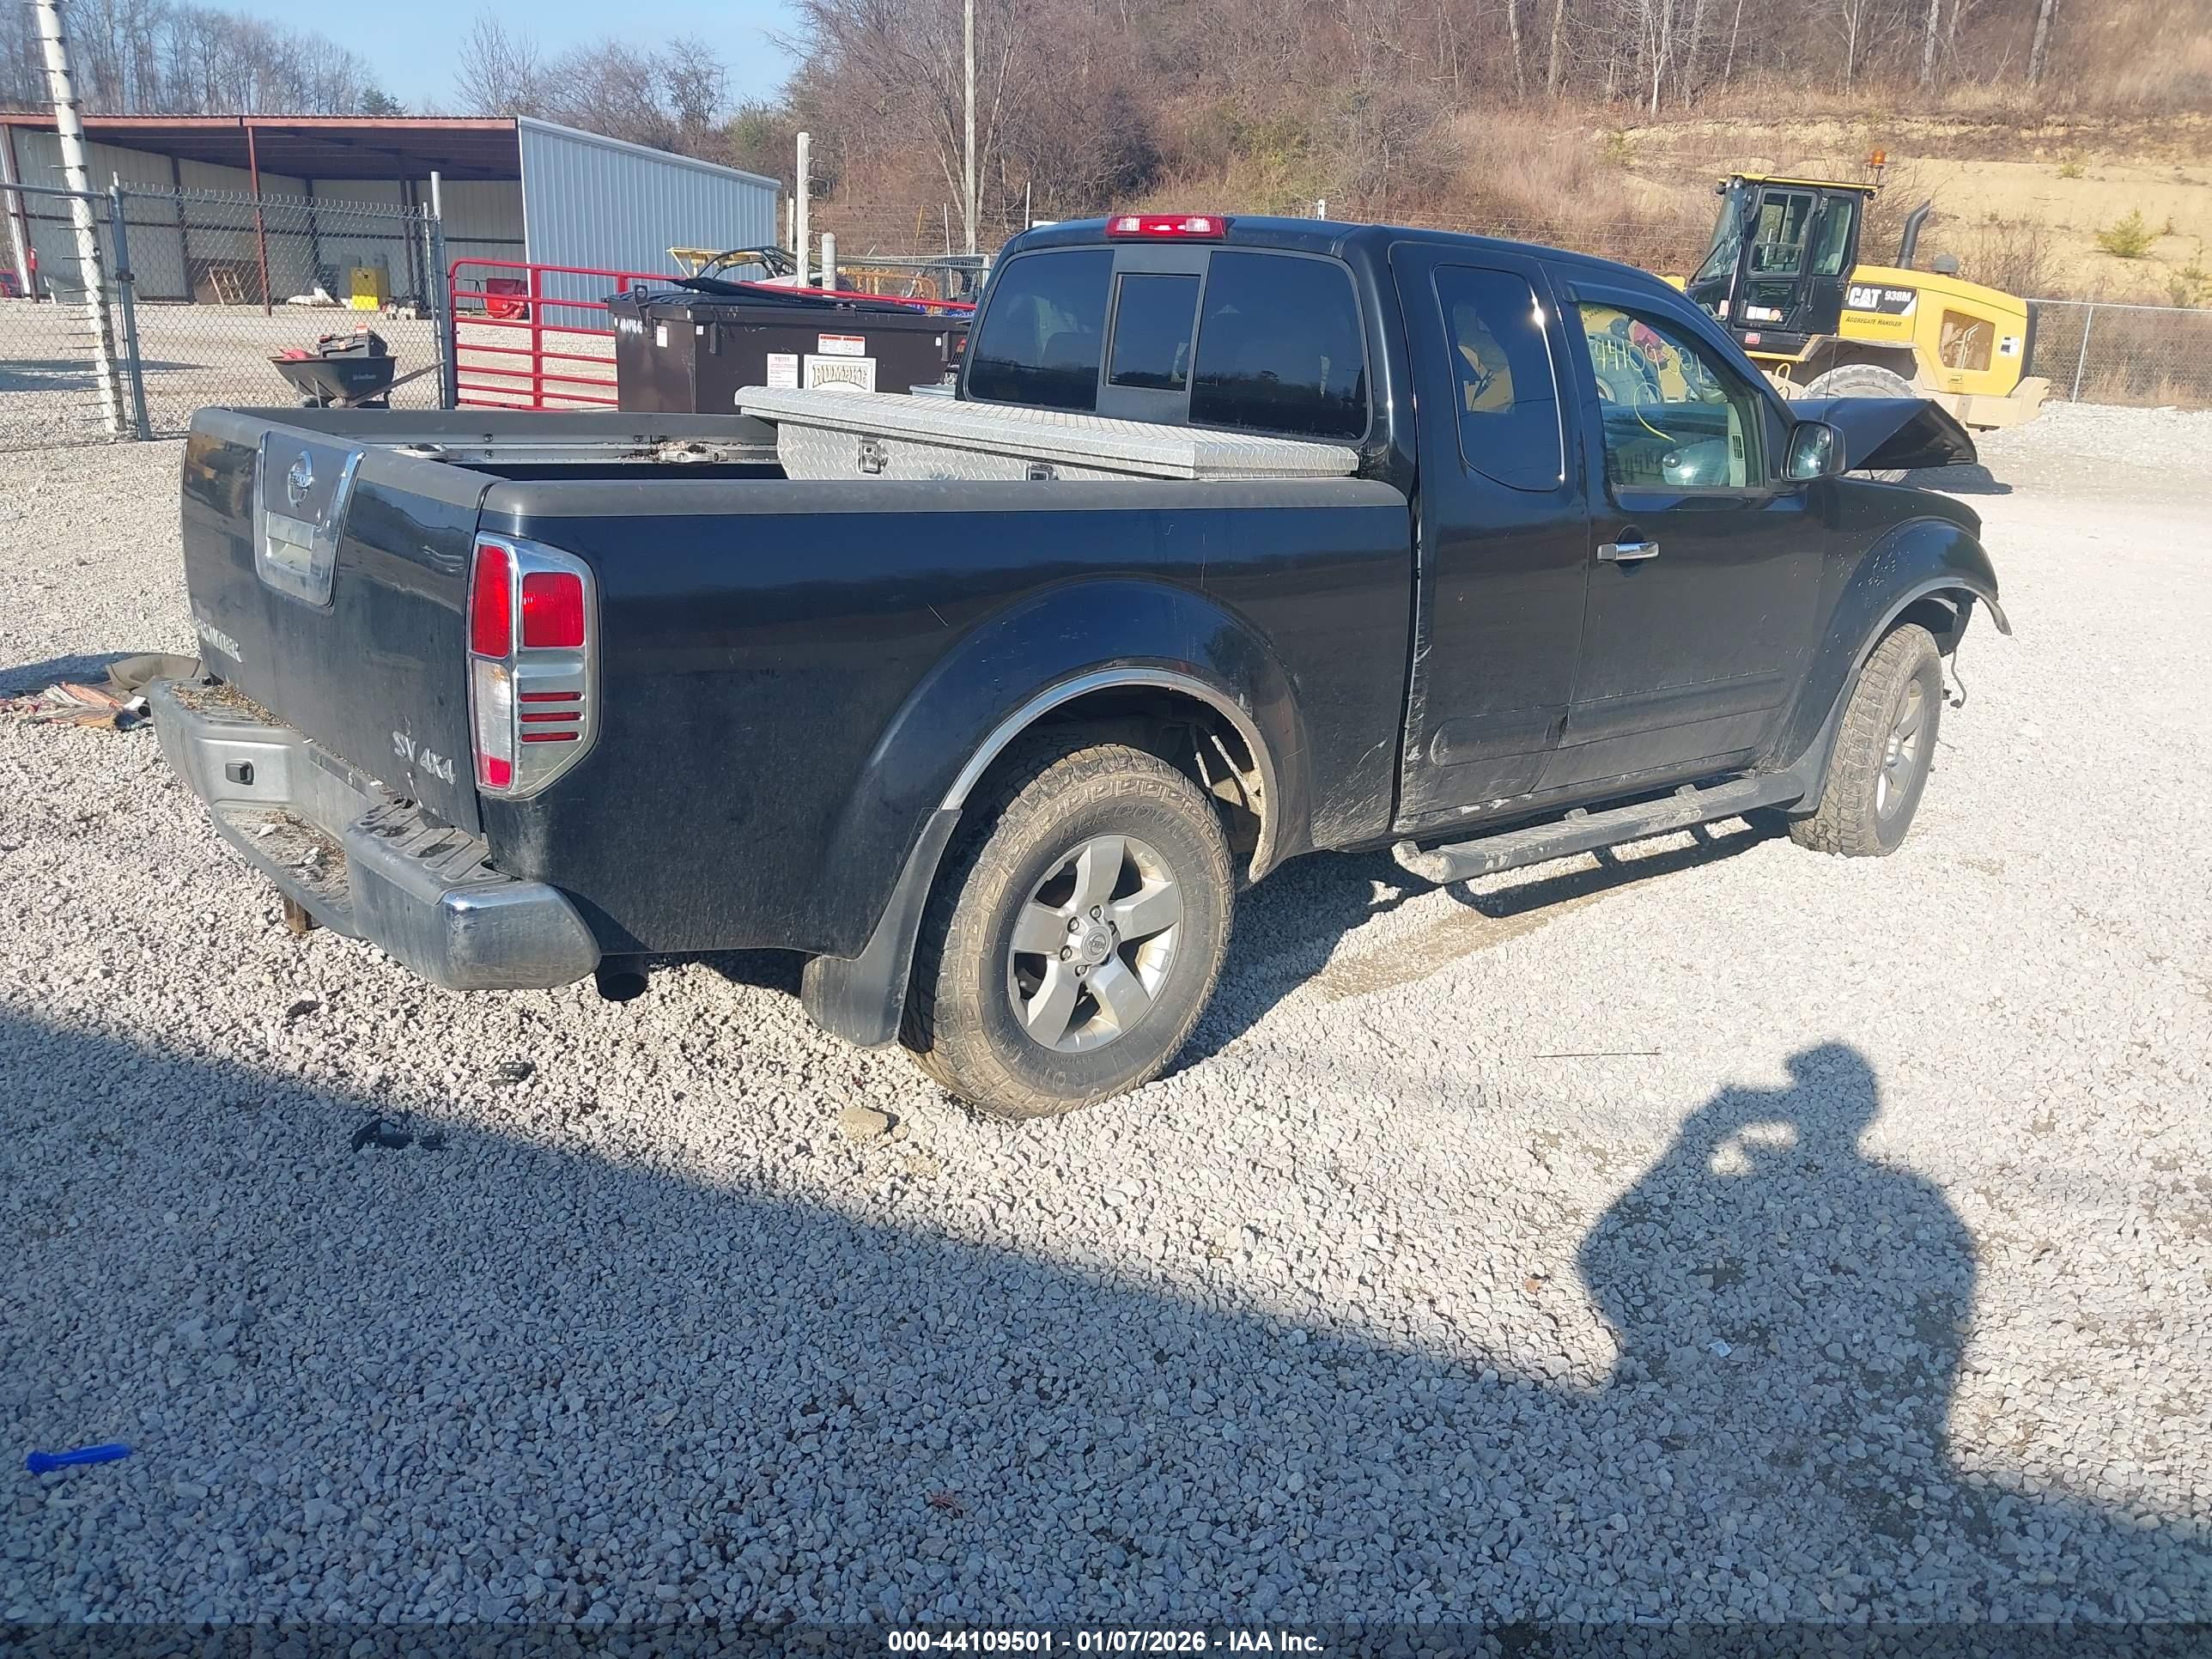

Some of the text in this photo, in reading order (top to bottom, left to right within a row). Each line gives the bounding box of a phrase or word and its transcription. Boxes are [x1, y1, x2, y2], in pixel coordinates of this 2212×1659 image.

[1848, 286, 1913, 309] CAT 938M
[1877, 319, 1903, 328] HANDLER
[812, 362, 868, 390] RUMPKE
[392, 731, 416, 763] SV
